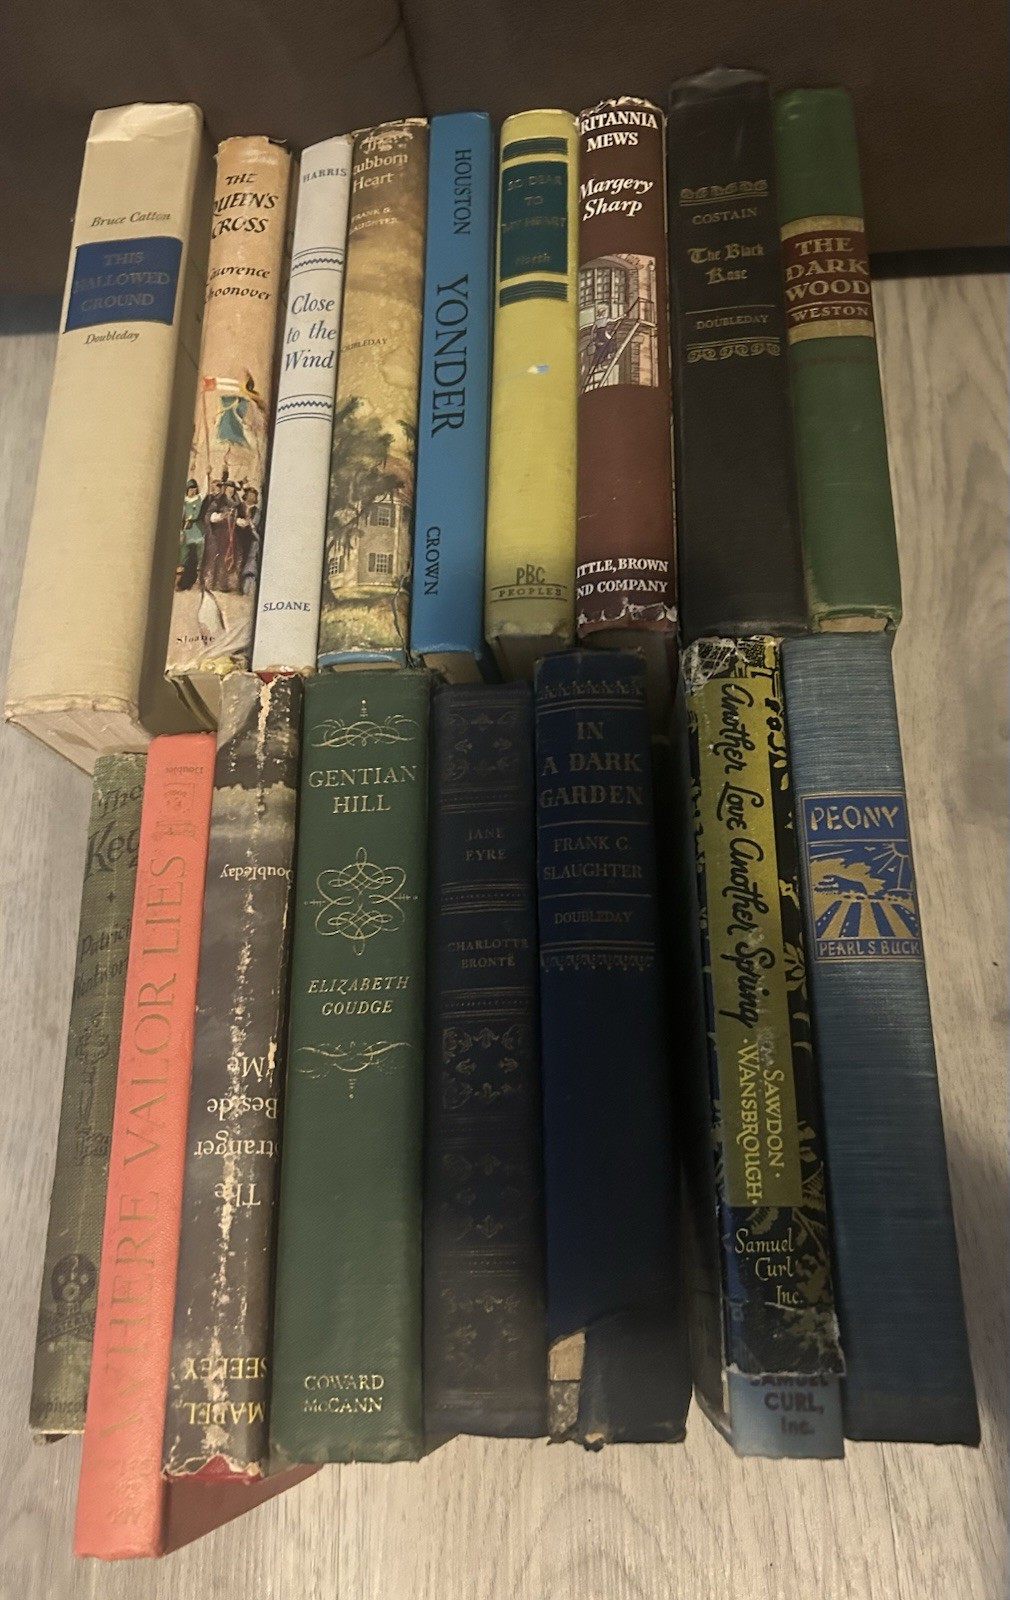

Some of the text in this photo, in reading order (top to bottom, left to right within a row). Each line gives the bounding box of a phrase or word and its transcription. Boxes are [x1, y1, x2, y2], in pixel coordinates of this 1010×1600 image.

[579, 110, 659, 136] RITANNIA
[586, 131, 639, 153] MEWS
[352, 153, 409, 176] ubborn
[225, 173, 258, 186] THE
[302, 167, 348, 184] HARRIS
[352, 172, 395, 193] Heart
[506, 174, 563, 192] SO DEAR
[453, 148, 472, 236] HOUSTON
[580, 177, 654, 200] Margery
[524, 195, 544, 206] TO
[582, 197, 643, 221] Sharp
[90, 211, 172, 228] Bruce Catton
[348, 216, 399, 235] AUGHTER
[692, 207, 759, 225] COSTAIN
[687, 242, 765, 265] The Black
[794, 237, 854, 256] THE
[103, 251, 145, 266] THIS
[207, 265, 271, 286] awrence
[705, 266, 749, 286] Rose
[785, 257, 871, 282] DARK
[72, 272, 171, 294] HALLOWED
[785, 278, 871, 302] WOOD
[80, 293, 155, 312] GROUND
[206, 286, 273, 305] hoonover
[290, 292, 336, 315] Close
[696, 314, 769, 331] DOUBLEDAY
[790, 305, 869, 323] WESTON
[84, 330, 140, 345] Doubleday
[286, 319, 337, 345] to the
[342, 337, 388, 353] OUBLEDAY
[284, 349, 336, 372] Wind
[431, 274, 470, 439] YONDER
[424, 525, 441, 596] CROWN
[577, 557, 669, 580] ITTLE, BROWN
[516, 563, 546, 585] PBC
[498, 586, 562, 598] PEOPLES
[576, 579, 668, 600] ND COMPANY
[262, 600, 312, 613] SLOANE
[576, 721, 604, 740] IN
[541, 752, 644, 776] A DARK
[308, 765, 418, 788] GENTIAN
[332, 794, 392, 814] HILL
[539, 785, 644, 808] GARDEN
[810, 805, 899, 831] PEONY
[467, 828, 506, 842] JANE
[553, 836, 610, 852] FRANK
[464, 849, 507, 862] EYRE
[712, 683, 776, 1029] Another Love Another Spring
[542, 863, 643, 881] SLAUGHTER
[142, 855, 187, 956] LIES
[554, 911, 633, 925] DOUBLEDAY
[79, 918, 131, 963] Patrici
[448, 938, 529, 952] CHARLOTTE
[819, 940, 921, 956] PEARL S BUCK
[307, 976, 411, 995] ELIZABETH
[321, 1000, 394, 1016] GOUDGE
[123, 972, 177, 1166] VALOR
[226, 1055, 266, 1079] Me
[736, 1042, 763, 1200] WANSBROUGH
[763, 1068, 785, 1169] SAWDON
[193, 1129, 278, 1157] tranger
[214, 1181, 262, 1208] The
[734, 1226, 795, 1255] Samuel
[754, 1255, 795, 1281] Curl
[776, 1285, 804, 1306] Inc.
[303, 1374, 385, 1390] COWARD
[303, 1397, 383, 1413] McCANN
[763, 1392, 825, 1415] CURL,
[780, 1417, 816, 1437] Inc.
